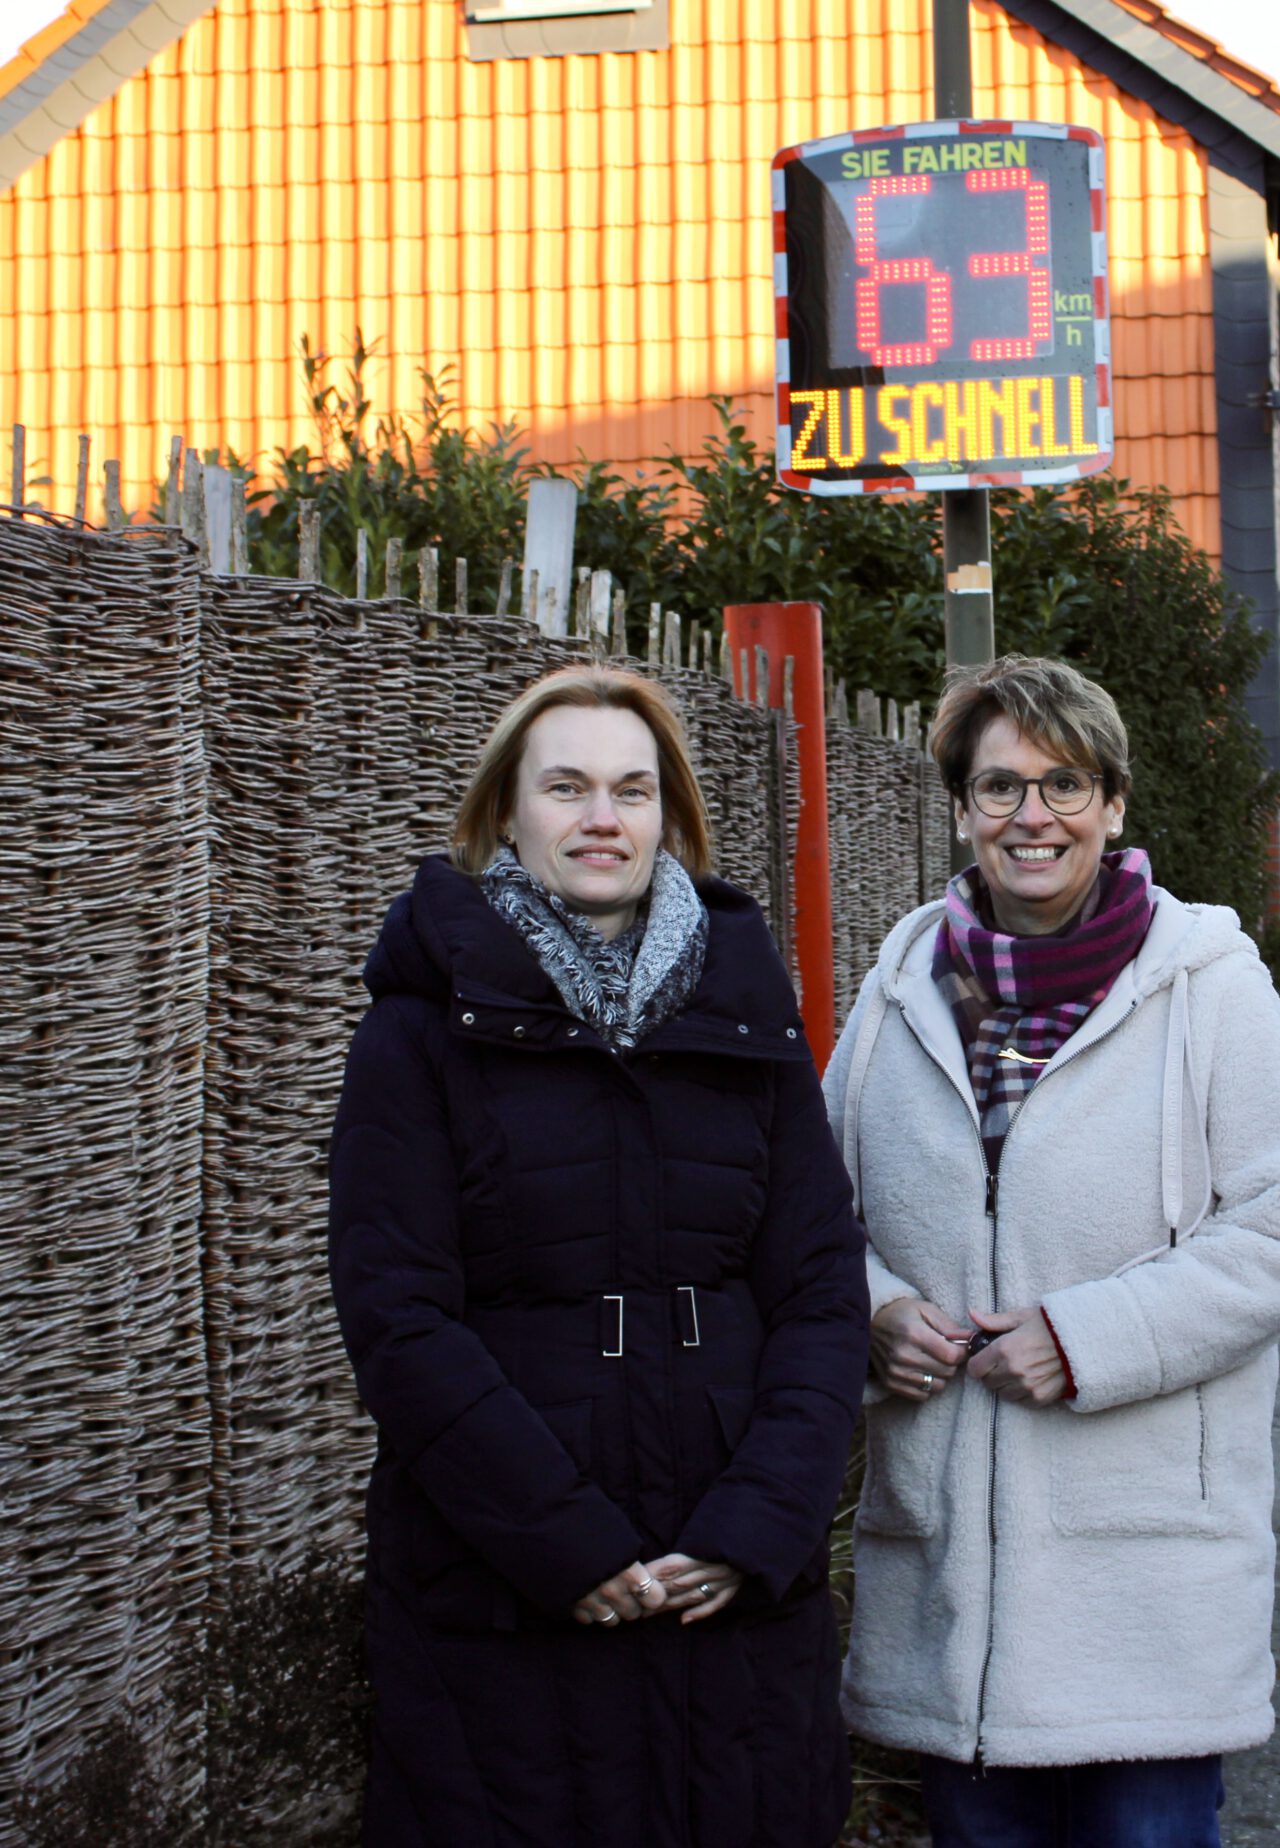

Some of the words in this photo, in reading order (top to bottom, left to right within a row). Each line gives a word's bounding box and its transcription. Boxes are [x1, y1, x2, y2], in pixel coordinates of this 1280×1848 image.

[842, 149, 891, 178] SIE
[902, 140, 1027, 173] FAHREN
[856, 167, 1050, 366] 63
[1054, 290, 1093, 312] km
[1066, 325, 1082, 345] h
[790, 386, 865, 470] ZU
[877, 375, 1098, 466] SCHNELL
